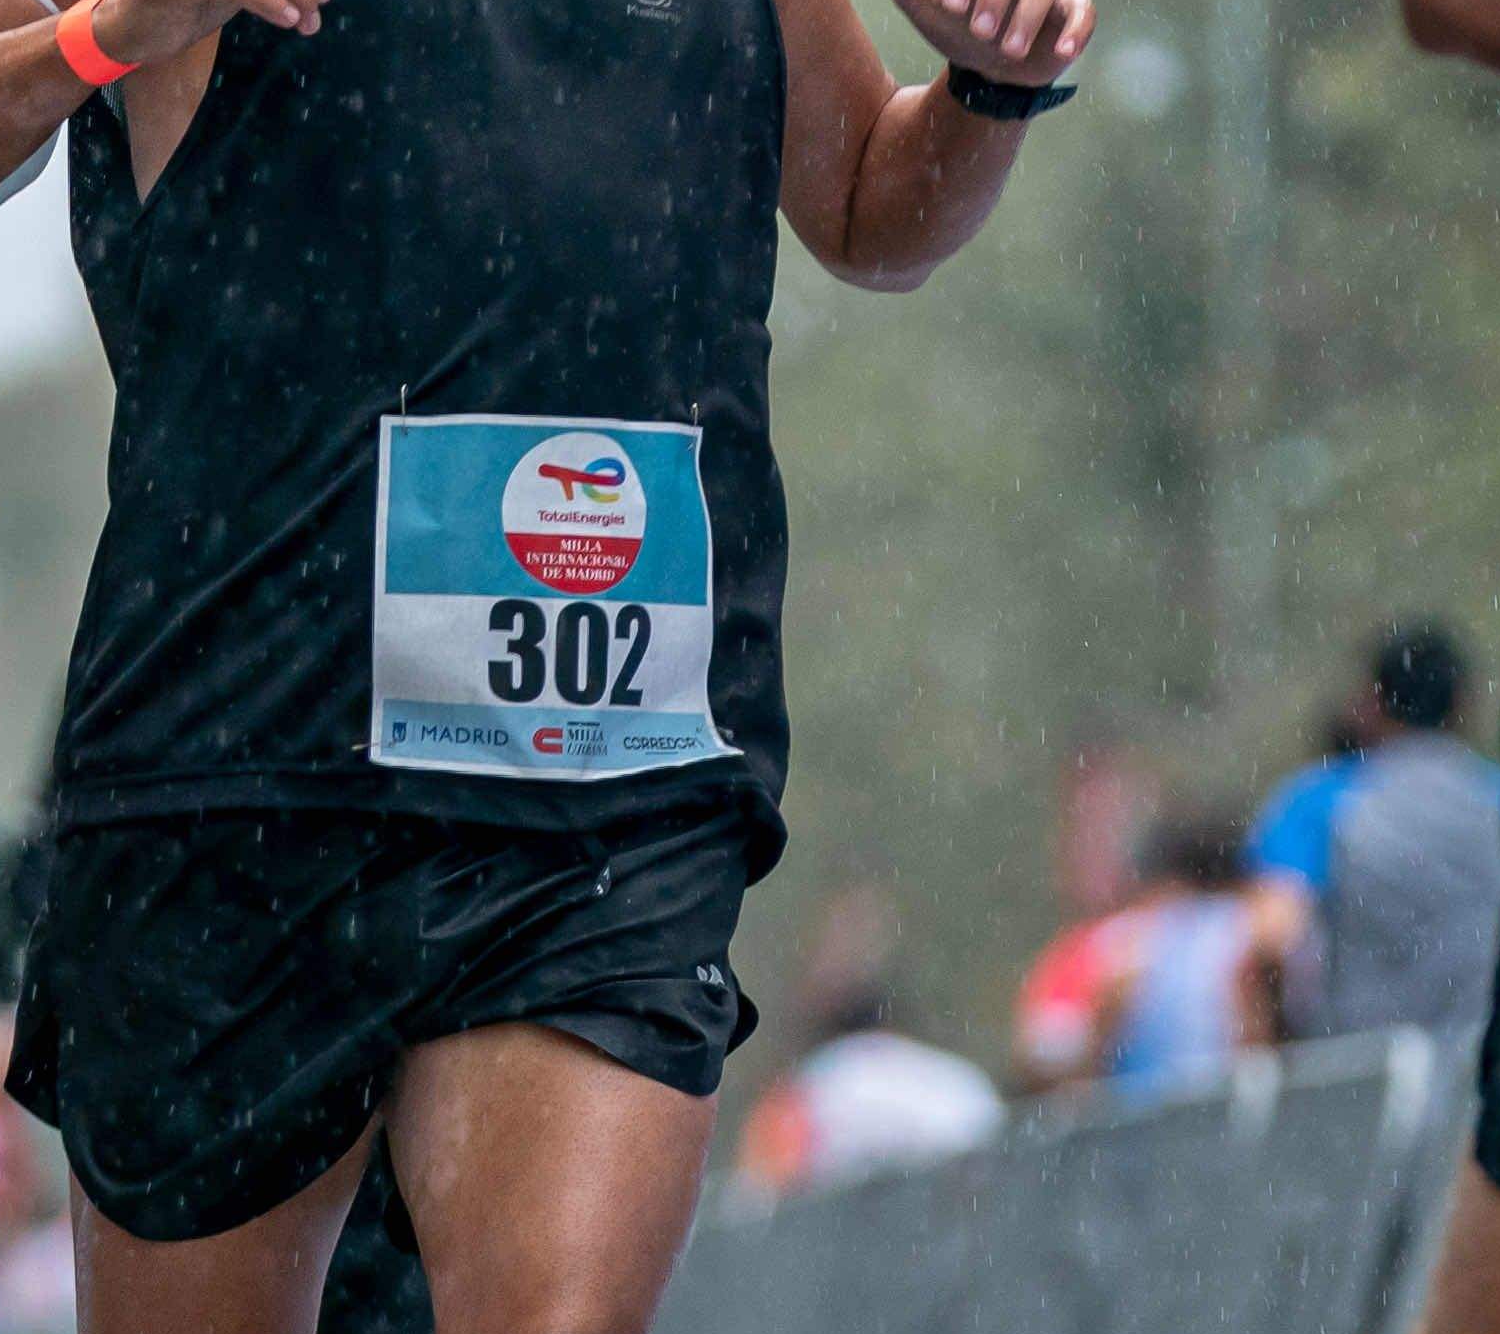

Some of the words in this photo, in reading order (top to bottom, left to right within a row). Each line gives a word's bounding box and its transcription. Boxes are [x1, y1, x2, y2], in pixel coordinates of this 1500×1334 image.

[537, 509, 626, 527] TotalEnergies
[559, 537, 603, 554] MILLA
[542, 566, 563, 581] DE
[564, 567, 617, 583] MADRID
[487, 598, 652, 708] 302
[420, 724, 510, 747] MADRID
